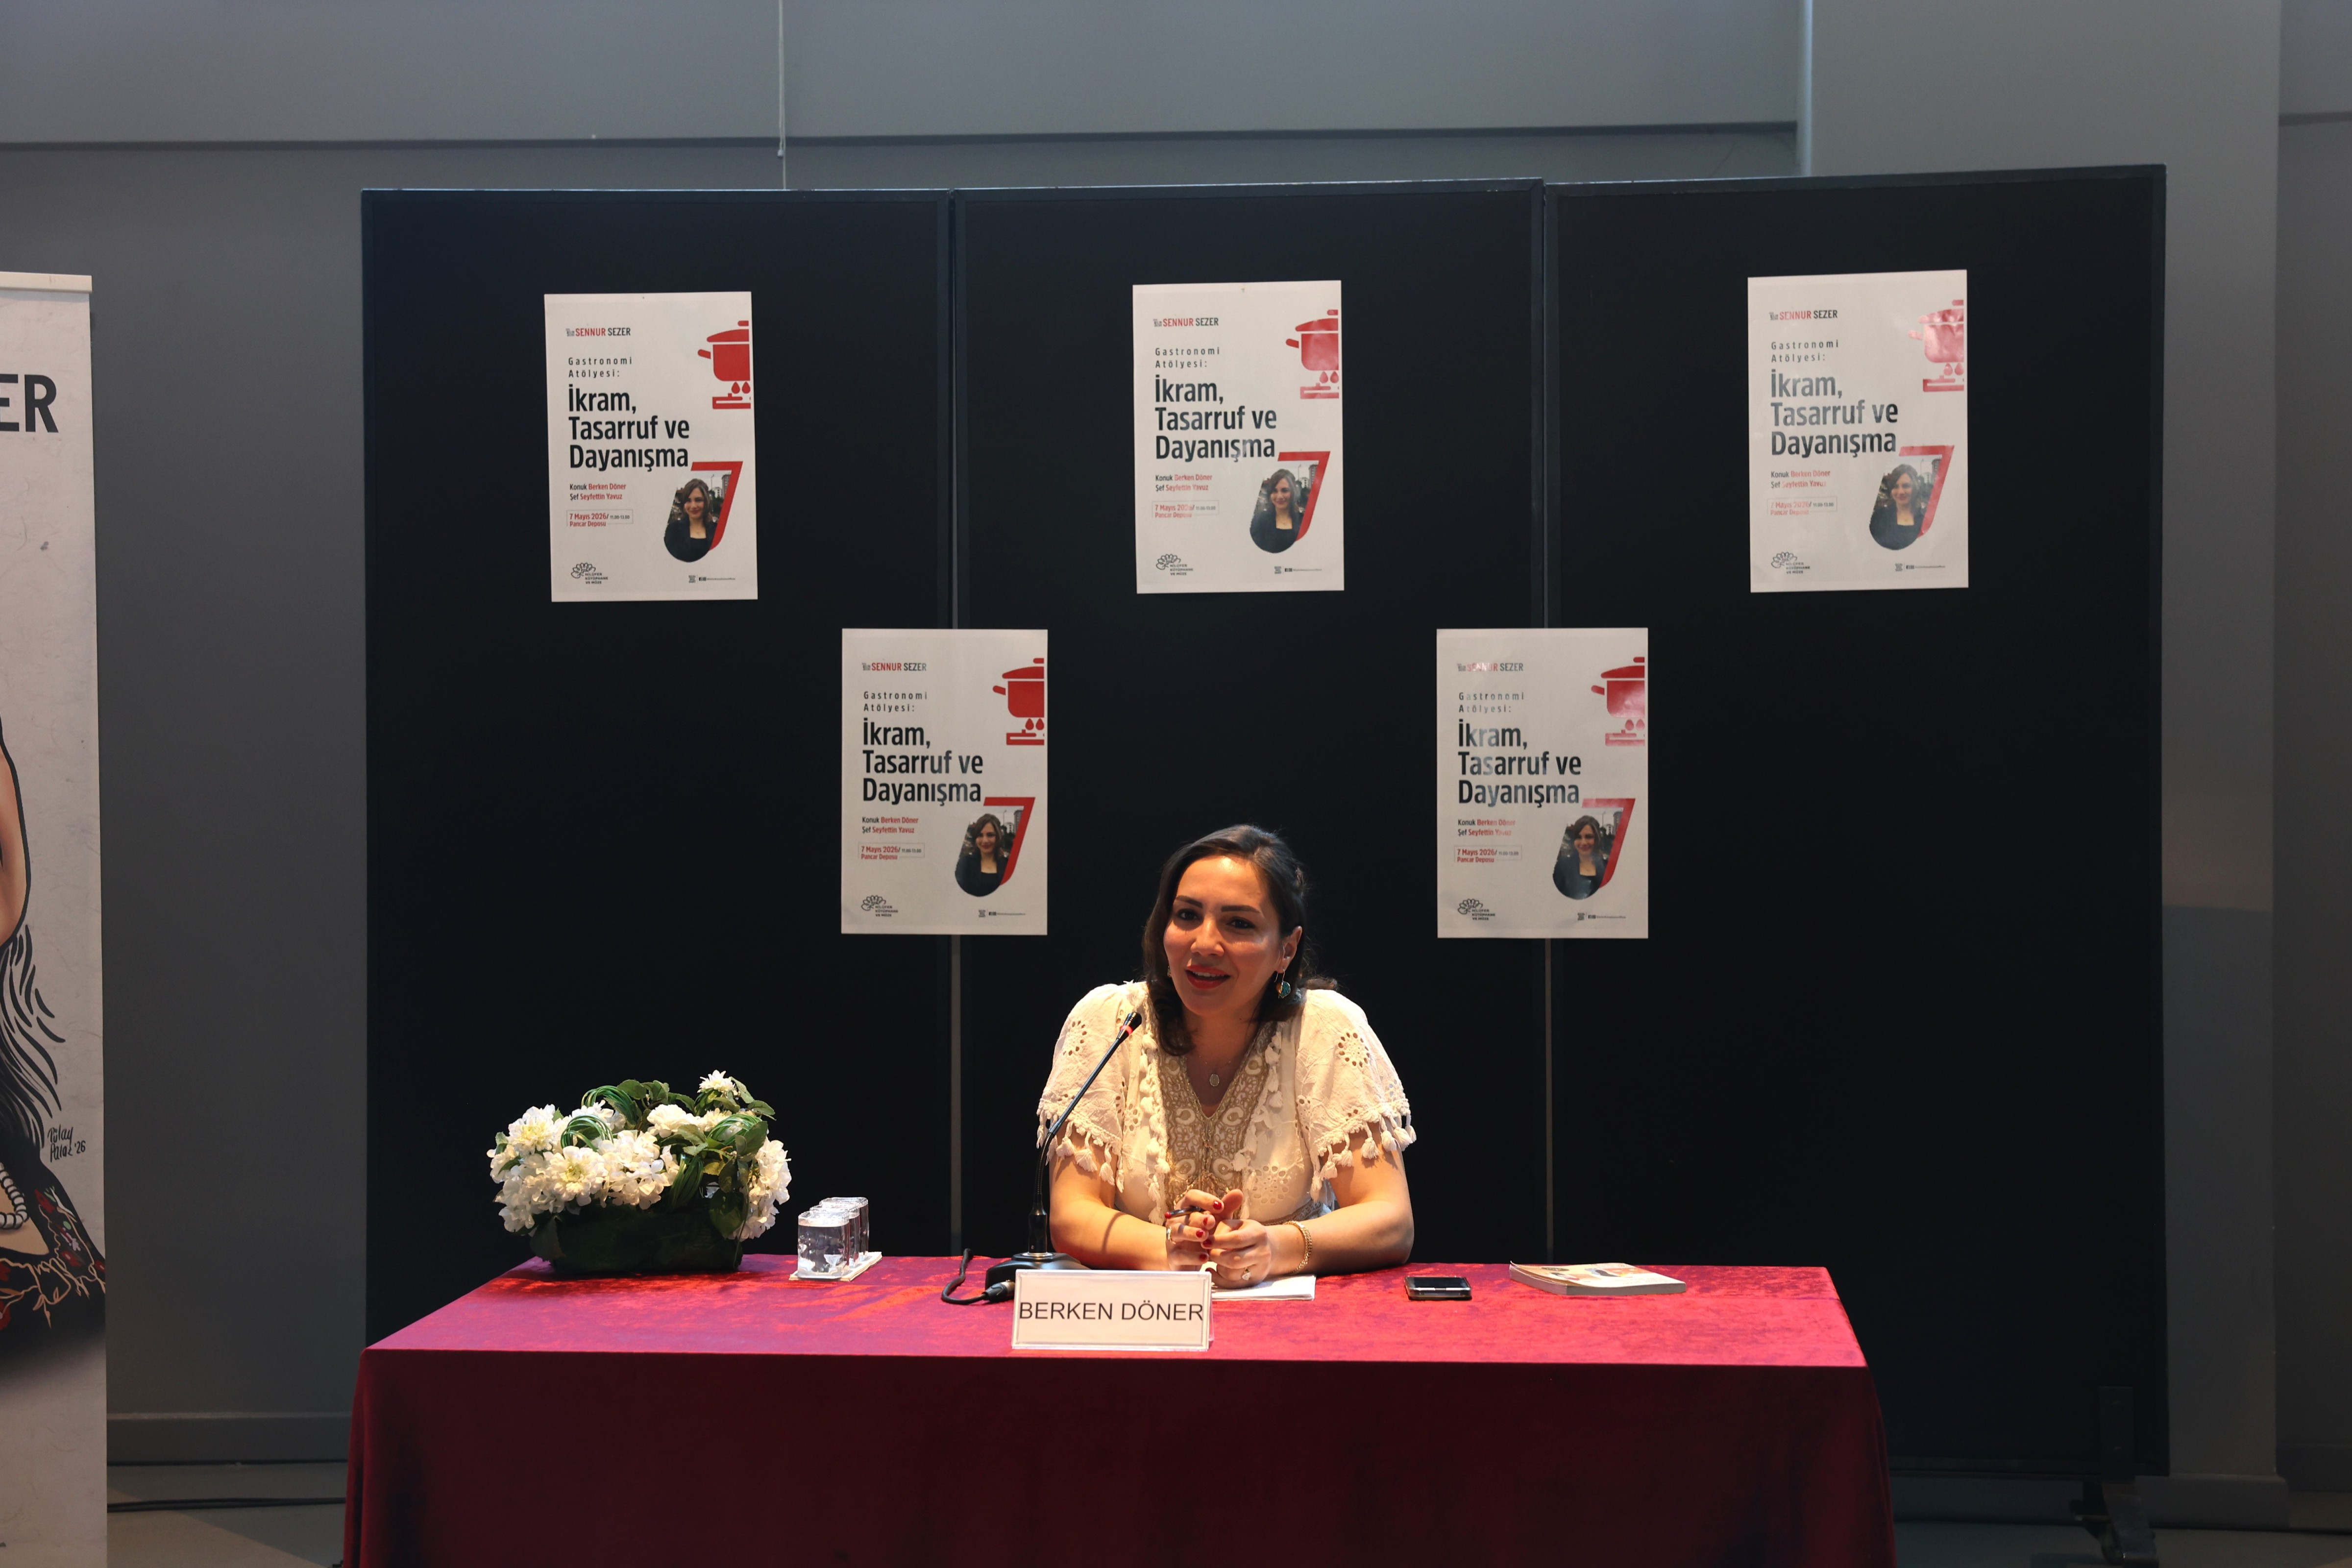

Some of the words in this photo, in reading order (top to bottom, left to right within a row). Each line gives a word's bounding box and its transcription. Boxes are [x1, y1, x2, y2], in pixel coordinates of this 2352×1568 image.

[1163, 318, 1194, 327] SENNUR
[1196, 318, 1219, 326] SEZER
[1779, 311, 1812, 320] SENNUR
[1813, 310, 1838, 318] SEZER
[575, 328, 606, 336] SENNUR
[1155, 347, 1220, 356] Gastronomi
[1771, 340, 1838, 350] Gastronomi
[568, 357, 632, 365] Gastronomi
[1155, 360, 1207, 369] Atölyesi:
[1771, 353, 1825, 363] Atölyesi:
[568, 369, 620, 379] Atölyesi:
[1771, 369, 1842, 398] İkram,
[569, 384, 637, 413] İkram,
[1155, 375, 1224, 404] İkram,
[1155, 406, 1245, 431] Tasarruf
[1252, 409, 1276, 429] ve
[1770, 400, 1865, 426] Tasarruf
[1872, 403, 1898, 423] ve
[568, 416, 658, 440] Tasarruf
[664, 419, 689, 439] ve
[1156, 436, 1274, 462] Dayanışma
[1771, 431, 1896, 458] Dayanışma
[570, 445, 688, 472] Dayanışma
[871, 662, 902, 671] SENNUR
[904, 662, 927, 671] SEZER
[1500, 663, 1523, 671] SEZER
[864, 704, 915, 712] Atölyesi:
[1459, 705, 1511, 713] Atölyesi:
[863, 718, 931, 748] İkram,
[1459, 719, 1527, 749] İkram,
[862, 750, 953, 774] Tasarruf
[958, 755, 983, 774] ve
[1458, 751, 1549, 775] Tasarruf
[1556, 756, 1581, 775] ve
[863, 778, 981, 806] Dayanışma
[1459, 780, 1579, 808] Dayanışma
[1019, 1302, 1113, 1320] BERKEN
[1121, 1300, 1204, 1321] DÖNER
